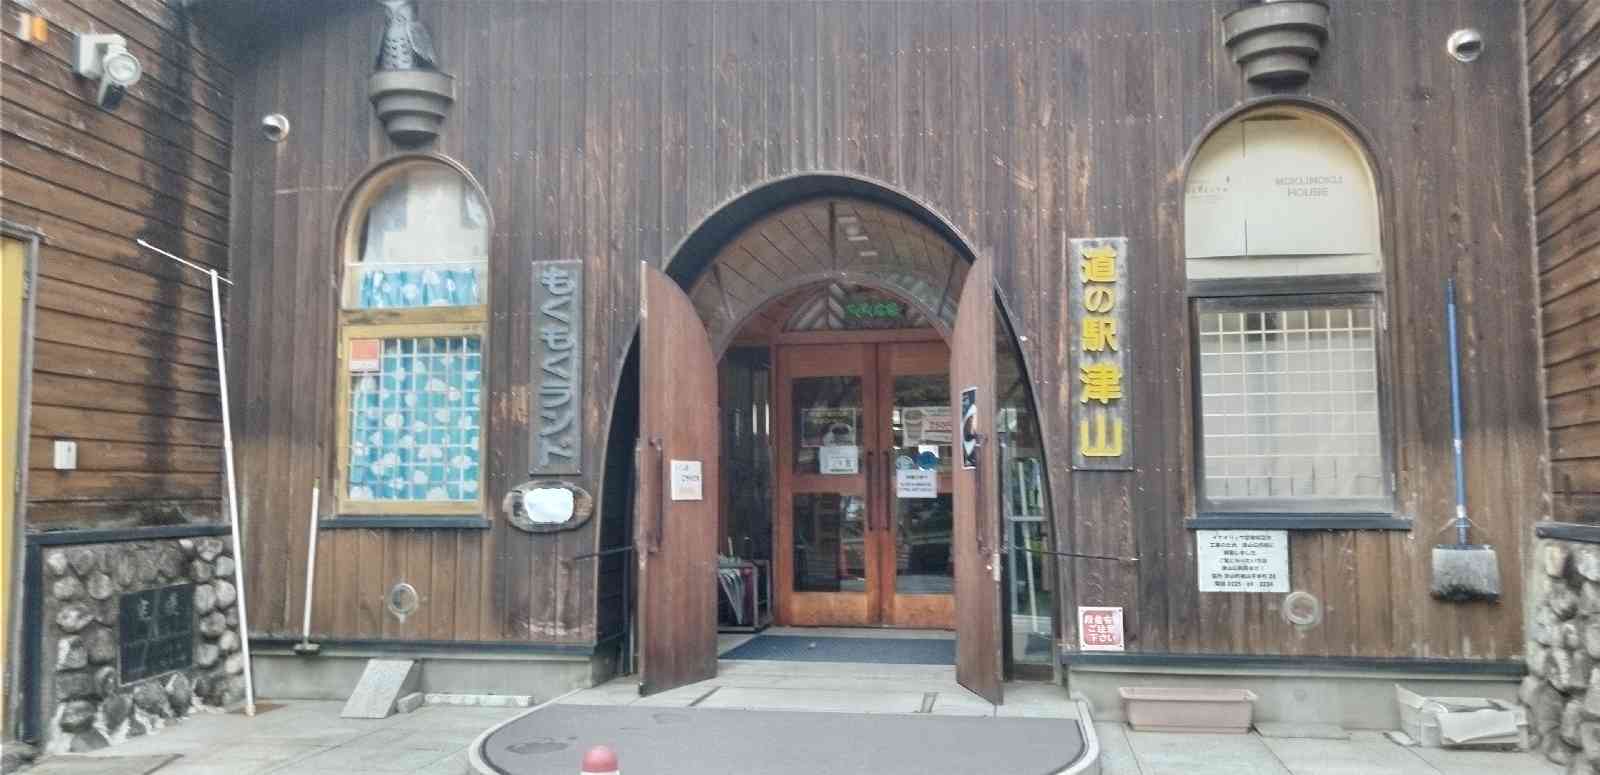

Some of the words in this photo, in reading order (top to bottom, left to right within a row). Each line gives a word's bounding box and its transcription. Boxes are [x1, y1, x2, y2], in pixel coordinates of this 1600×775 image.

[1287, 187, 1329, 197] HOUSE
[539, 265, 575, 466] もくもくランド
[1080, 244, 1123, 457] 道の駅津山
